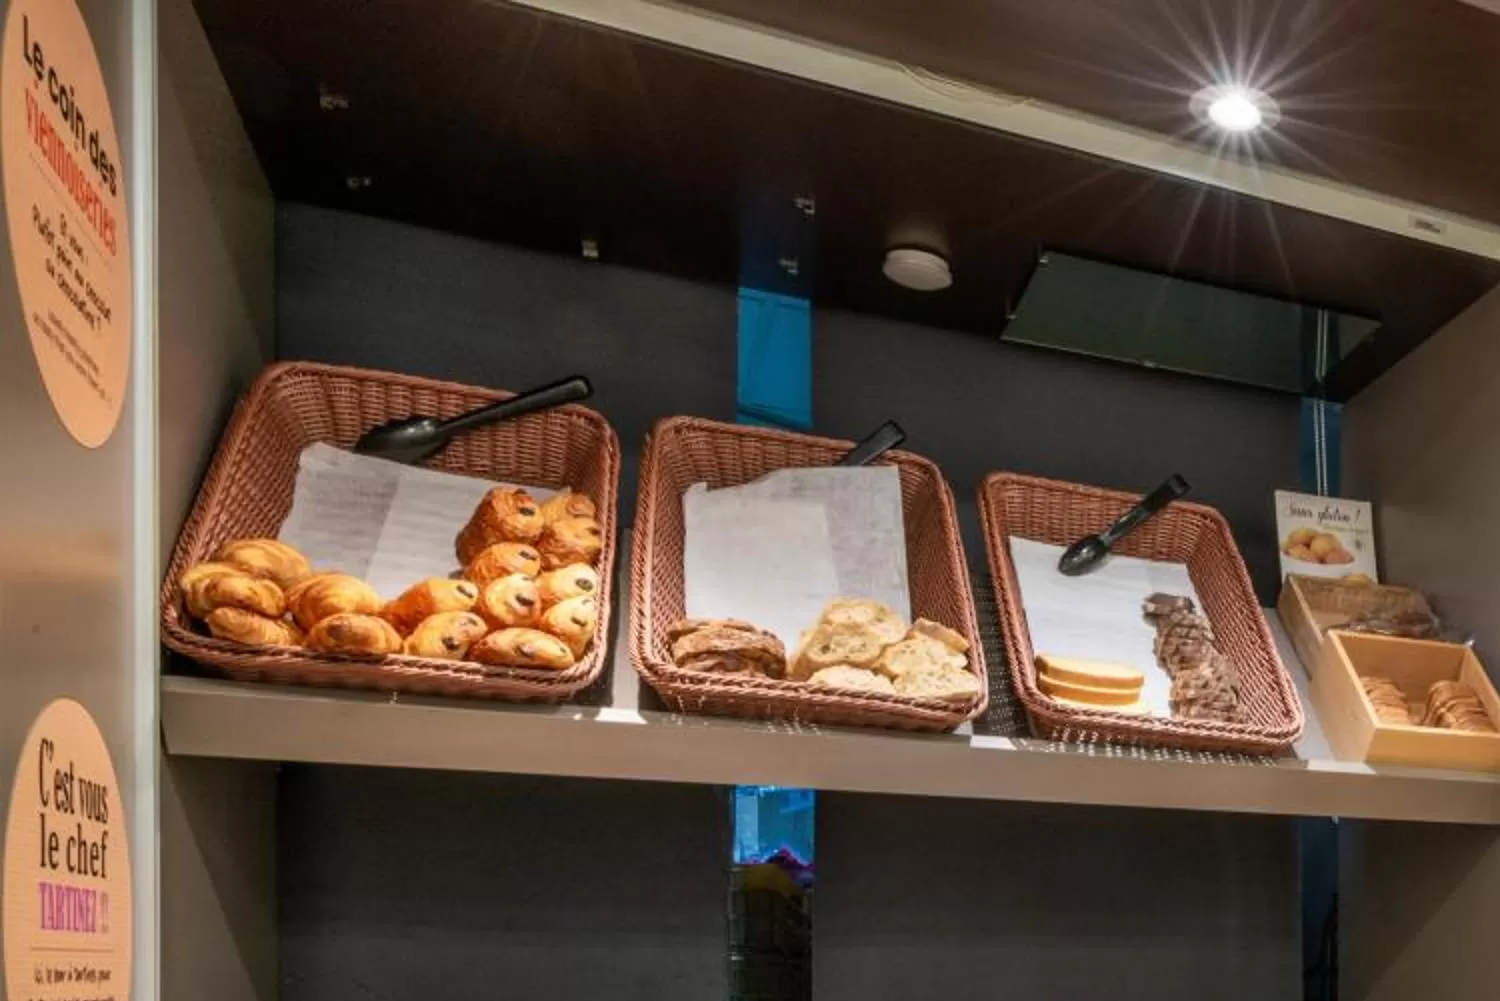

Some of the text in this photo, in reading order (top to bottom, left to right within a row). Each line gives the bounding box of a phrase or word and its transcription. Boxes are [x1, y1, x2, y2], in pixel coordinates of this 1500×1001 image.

[23, 14, 117, 197] Le coin des
[39, 738, 108, 824] C'est vous
[40, 813, 108, 879] le chef
[39, 882, 97, 933] TARTINEZ
